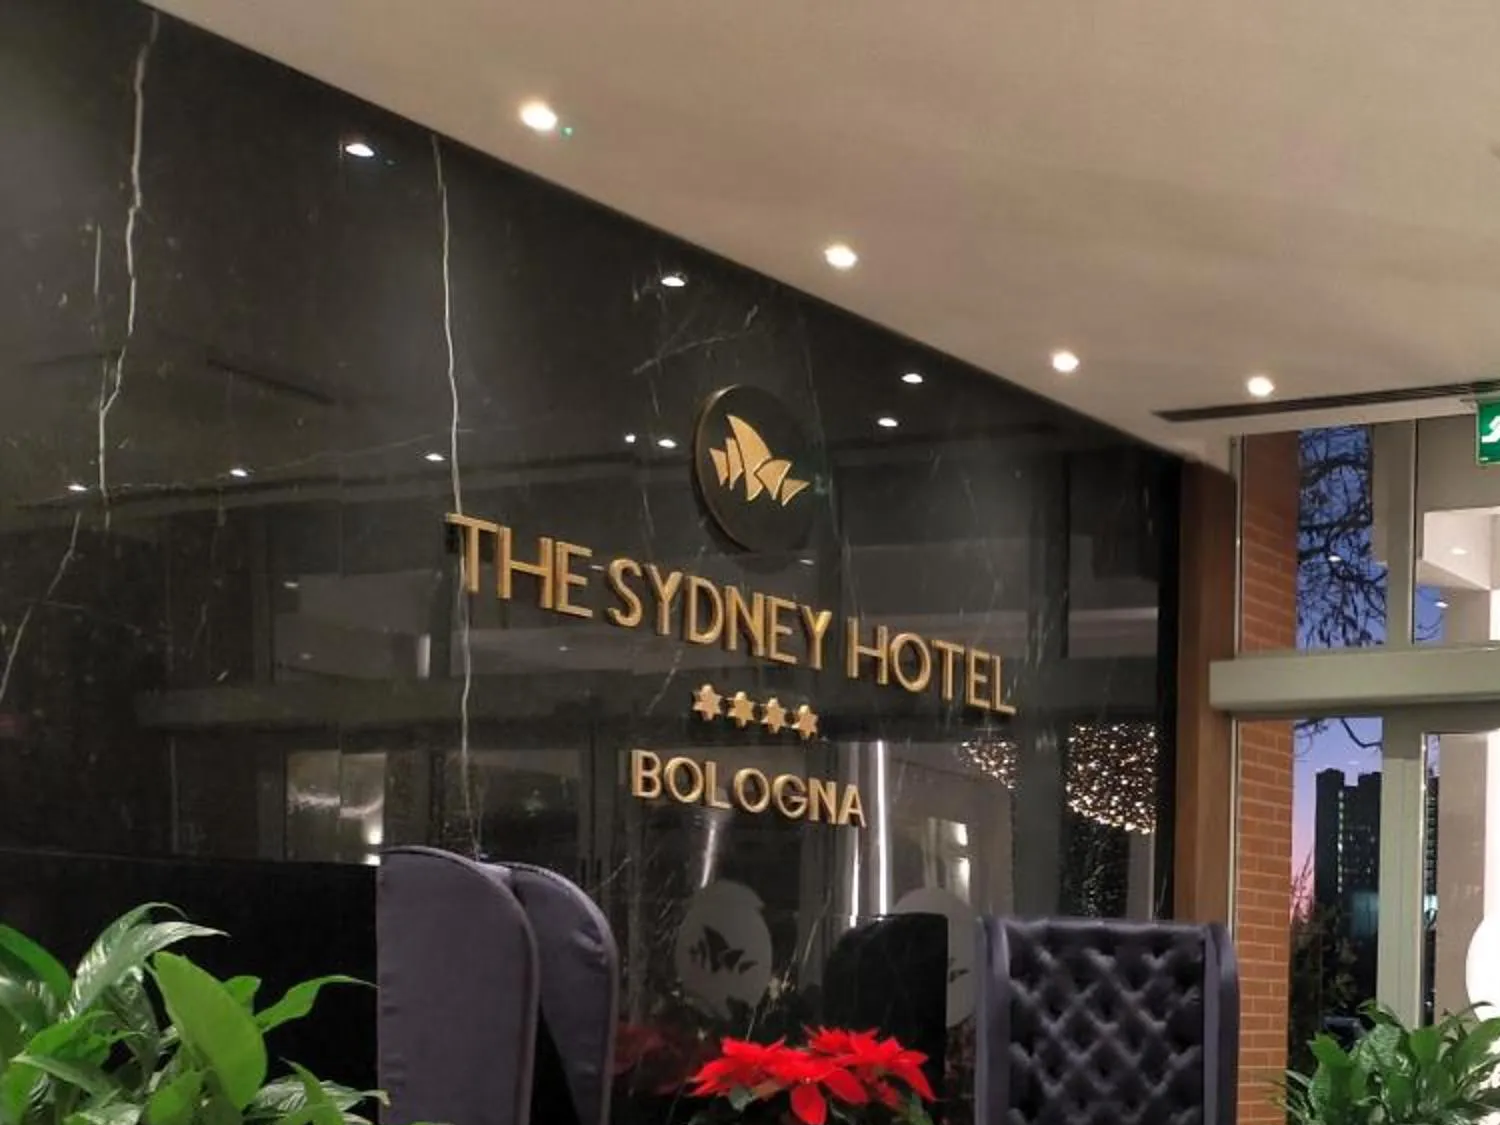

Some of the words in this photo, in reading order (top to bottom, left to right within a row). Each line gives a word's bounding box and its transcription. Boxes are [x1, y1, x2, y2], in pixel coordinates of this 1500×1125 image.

[445, 511, 593, 619] THE
[605, 557, 832, 670] SYDNEY
[846, 616, 1017, 715] HOTEL
[631, 748, 867, 829] BOLOGNA
